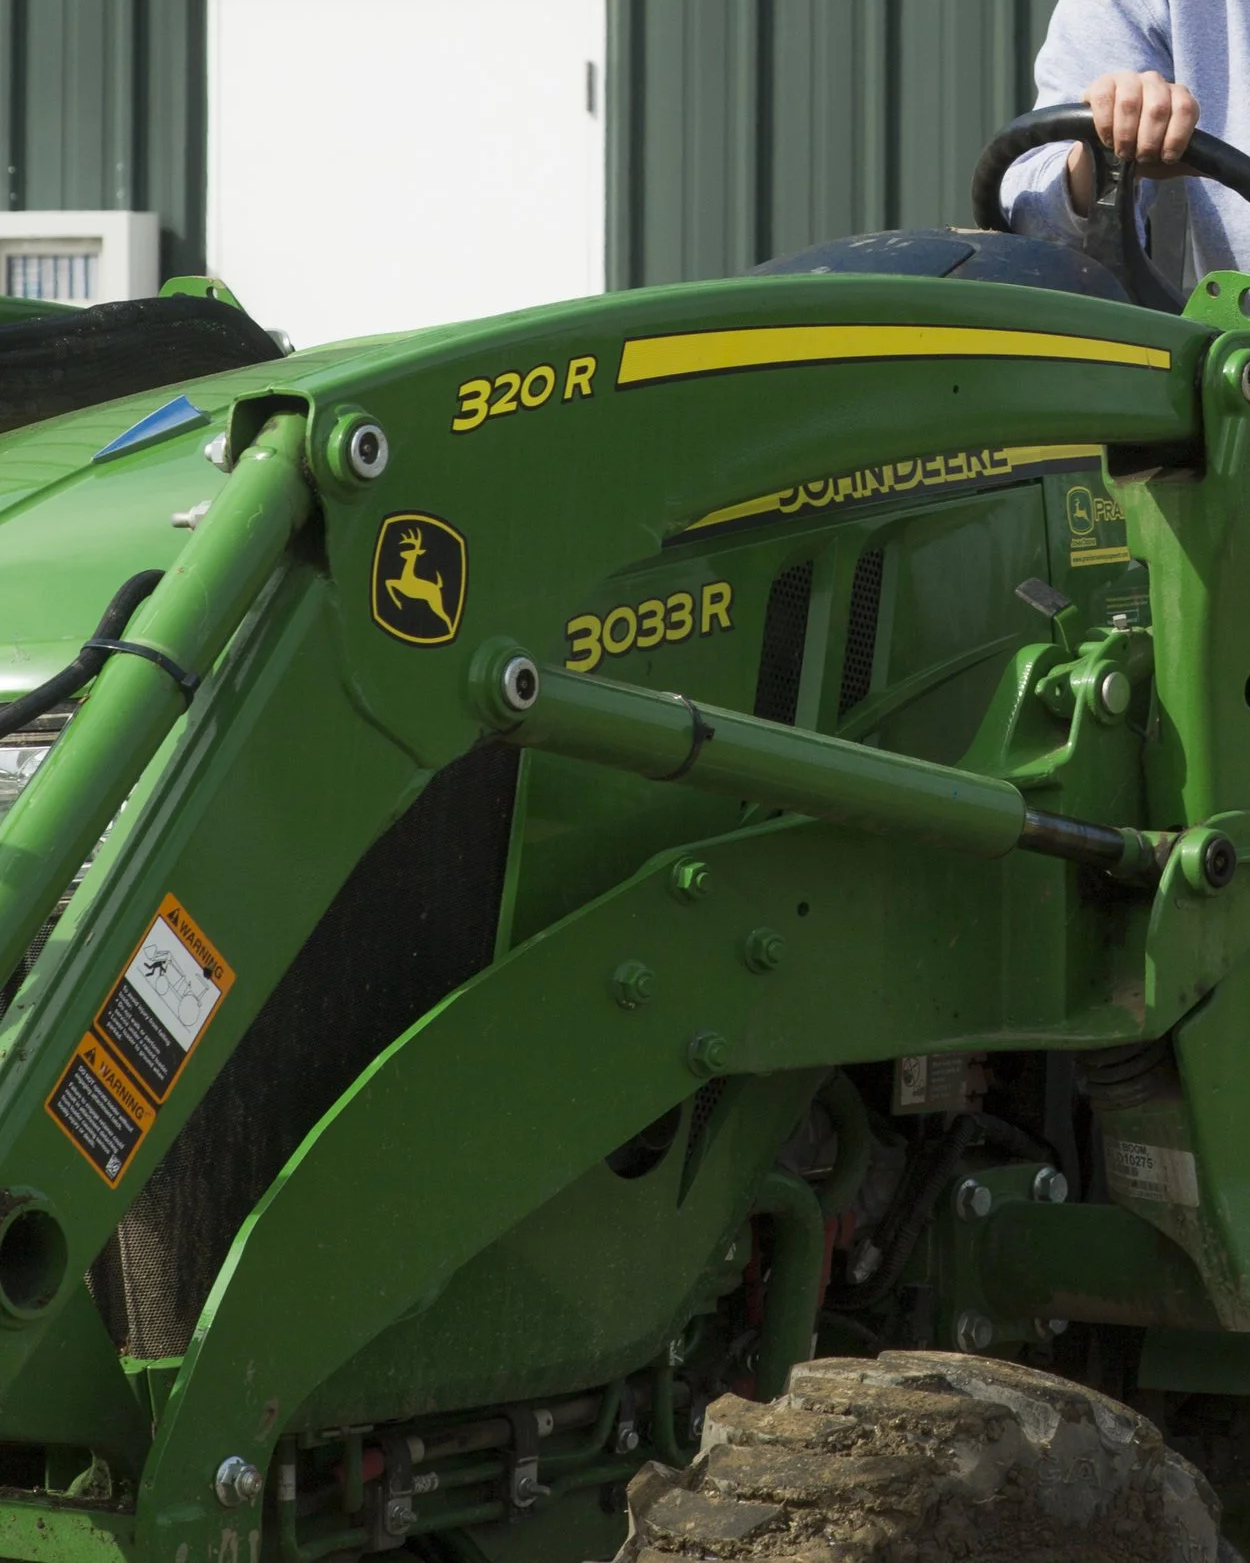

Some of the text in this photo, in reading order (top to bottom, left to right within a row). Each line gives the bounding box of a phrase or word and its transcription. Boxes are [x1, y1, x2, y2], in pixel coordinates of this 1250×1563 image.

[451, 354, 597, 433] 320 R
[565, 580, 734, 674] 3033 R
[179, 921, 224, 980] WARNING
[100, 1061, 145, 1119] WARNING
